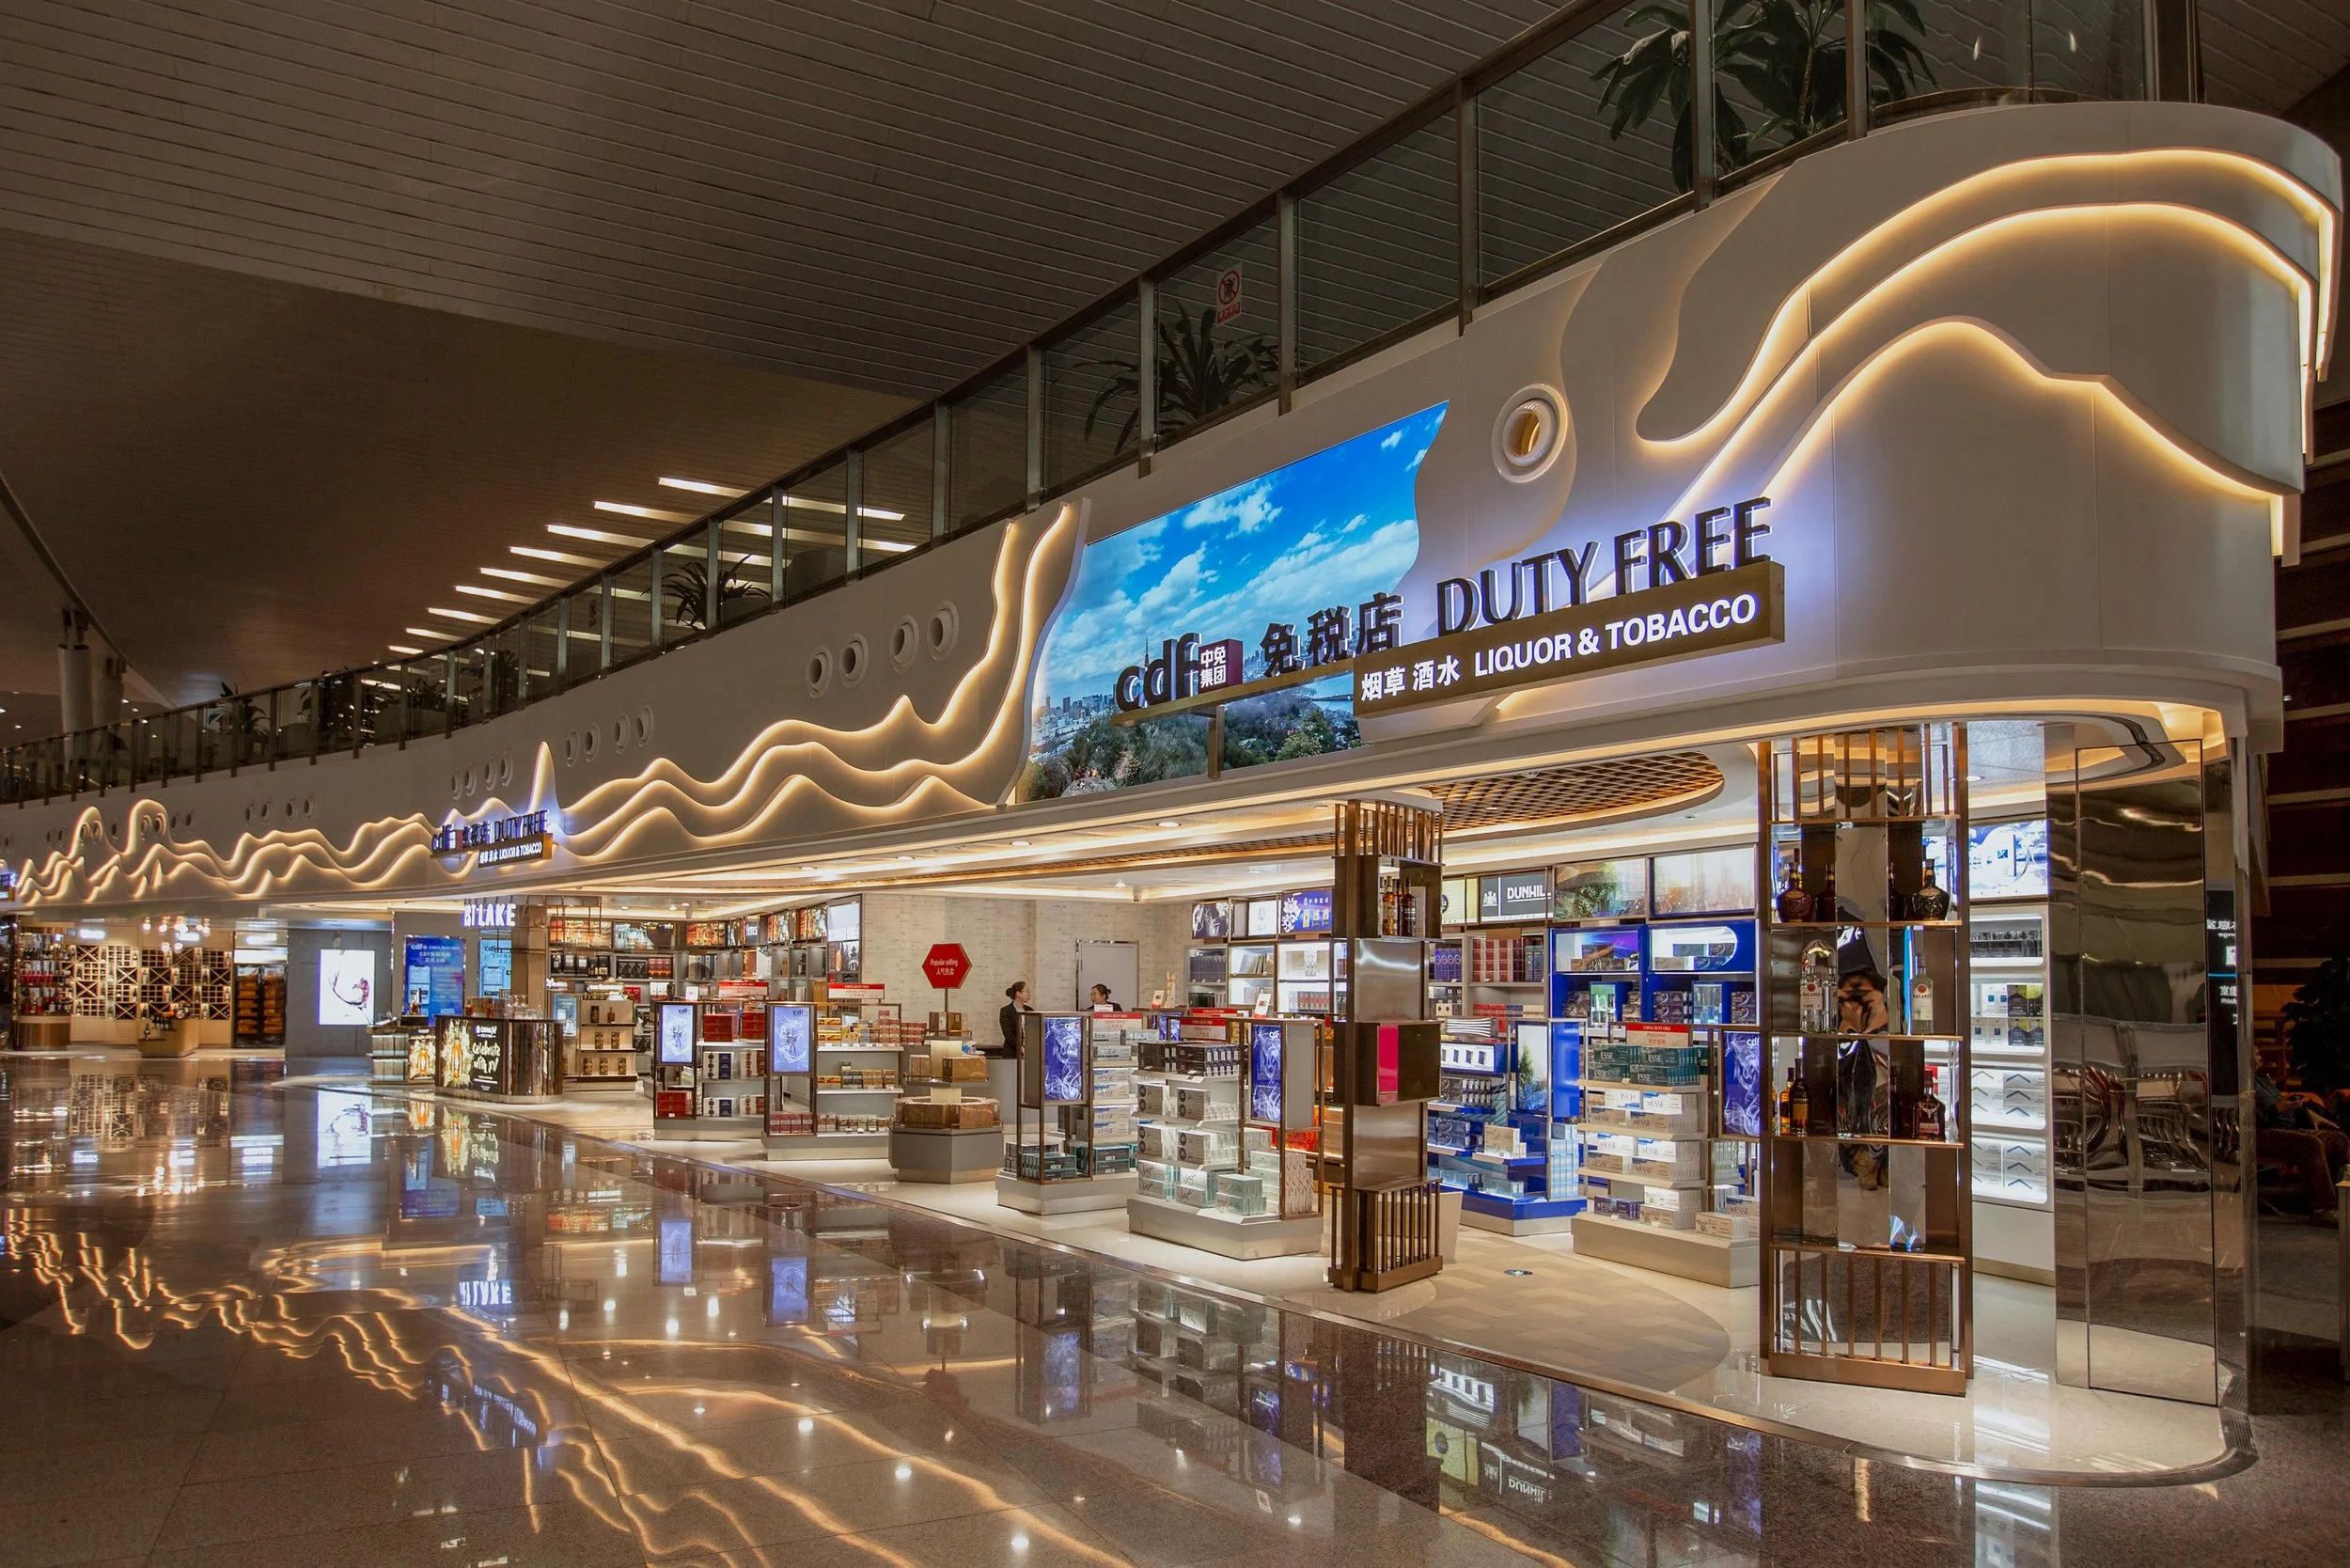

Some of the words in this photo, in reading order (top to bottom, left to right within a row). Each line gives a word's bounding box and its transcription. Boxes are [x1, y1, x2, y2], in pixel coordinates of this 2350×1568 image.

[1115, 633, 1201, 712] cdf
[1260, 592, 1403, 678] 免税店
[1437, 541, 1601, 636] DUTY
[1615, 496, 1774, 595] FREE
[1200, 646, 1226, 667] 中免
[1361, 666, 1406, 702] 烟草
[1412, 655, 1461, 692] 酒水
[1474, 633, 1572, 677] LIQUOR
[1576, 627, 1600, 654] &
[1605, 593, 1756, 651] TOBACCO
[1200, 665, 1226, 688] 集团
[522, 809, 550, 838] FREE
[478, 902, 517, 927] LAKE
[472, 1040, 501, 1058] Celebrate
[1600, 1051, 1614, 1060] ESSE
[1648, 1054, 1663, 1062] ESSE
